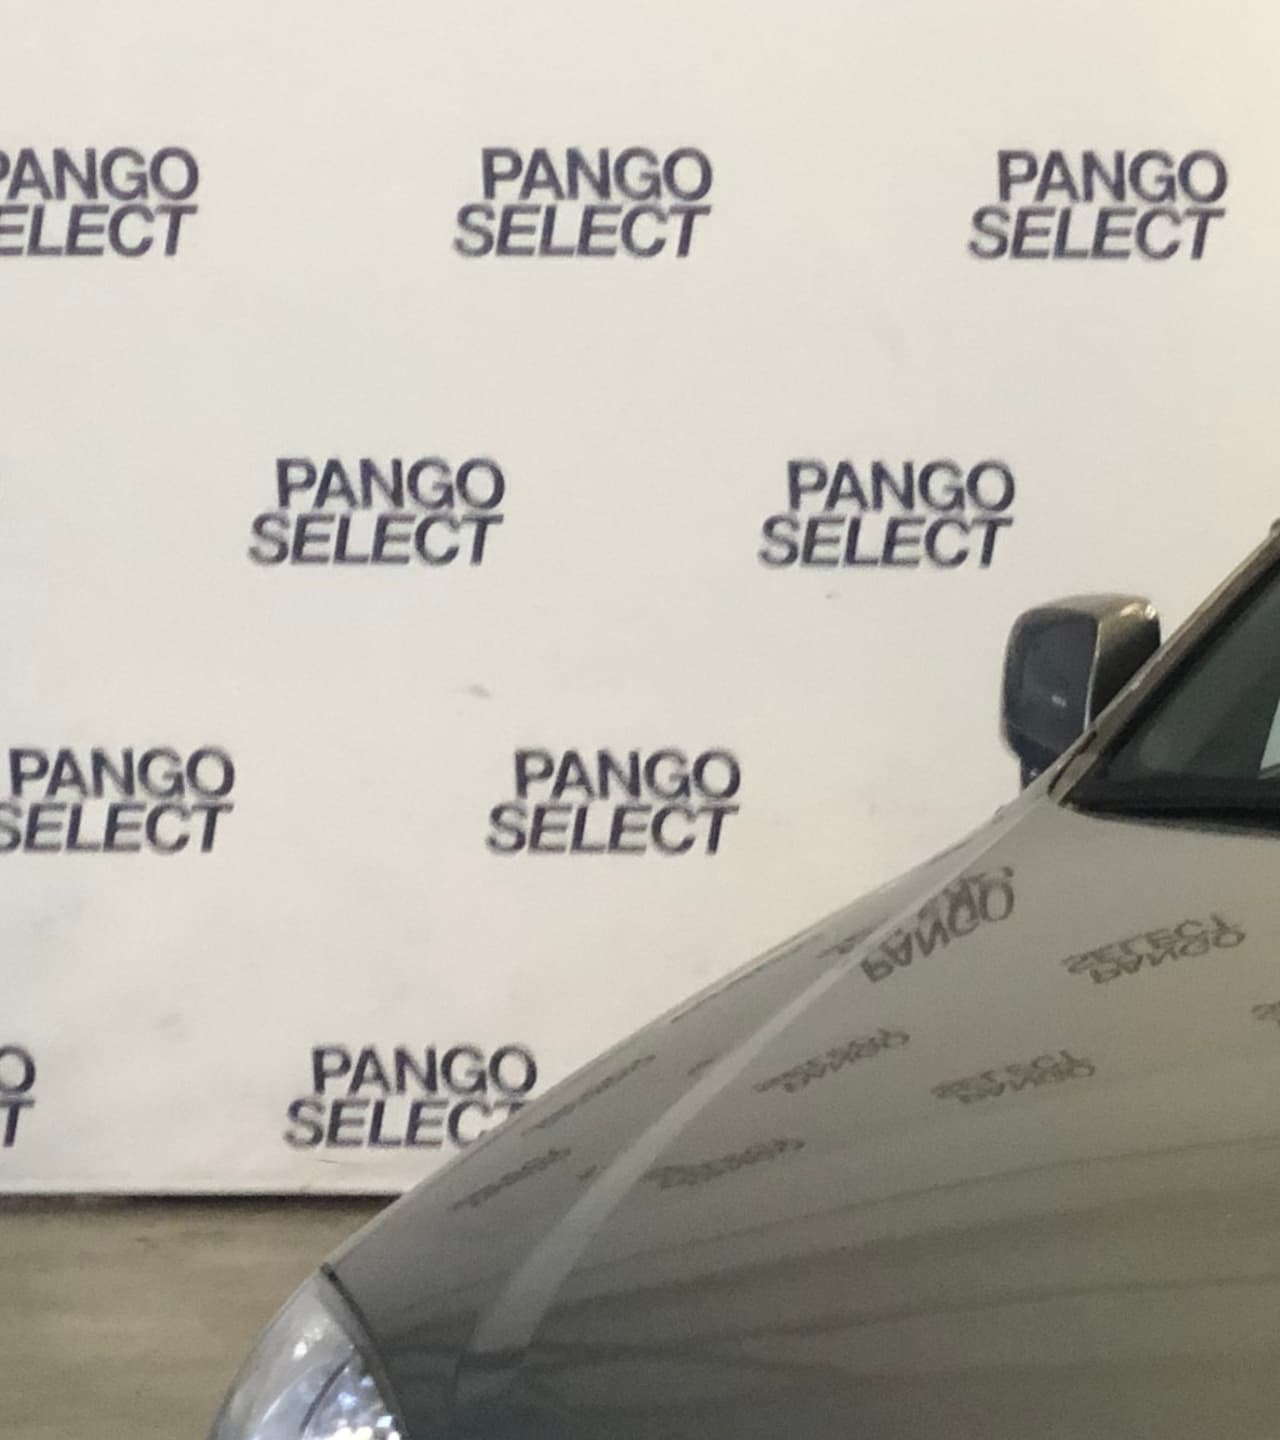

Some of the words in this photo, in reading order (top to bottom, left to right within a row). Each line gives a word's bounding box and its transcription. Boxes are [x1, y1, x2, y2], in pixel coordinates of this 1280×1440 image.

[0, 147, 199, 201] ANGO
[482, 147, 713, 202] PANGO
[997, 149, 1228, 204] PANGO
[0, 203, 198, 258] ELECT
[455, 203, 711, 258] SELECT
[969, 206, 1226, 261] SELECT
[276, 458, 506, 512] PANGO
[787, 460, 1016, 513] PANGO
[248, 512, 504, 567] SELECT
[758, 514, 1014, 569] SELECT
[9, 747, 235, 802] PANGO
[514, 749, 741, 803] PANGO
[485, 803, 740, 855] SELECT
[311, 1046, 538, 1098] PANGO
